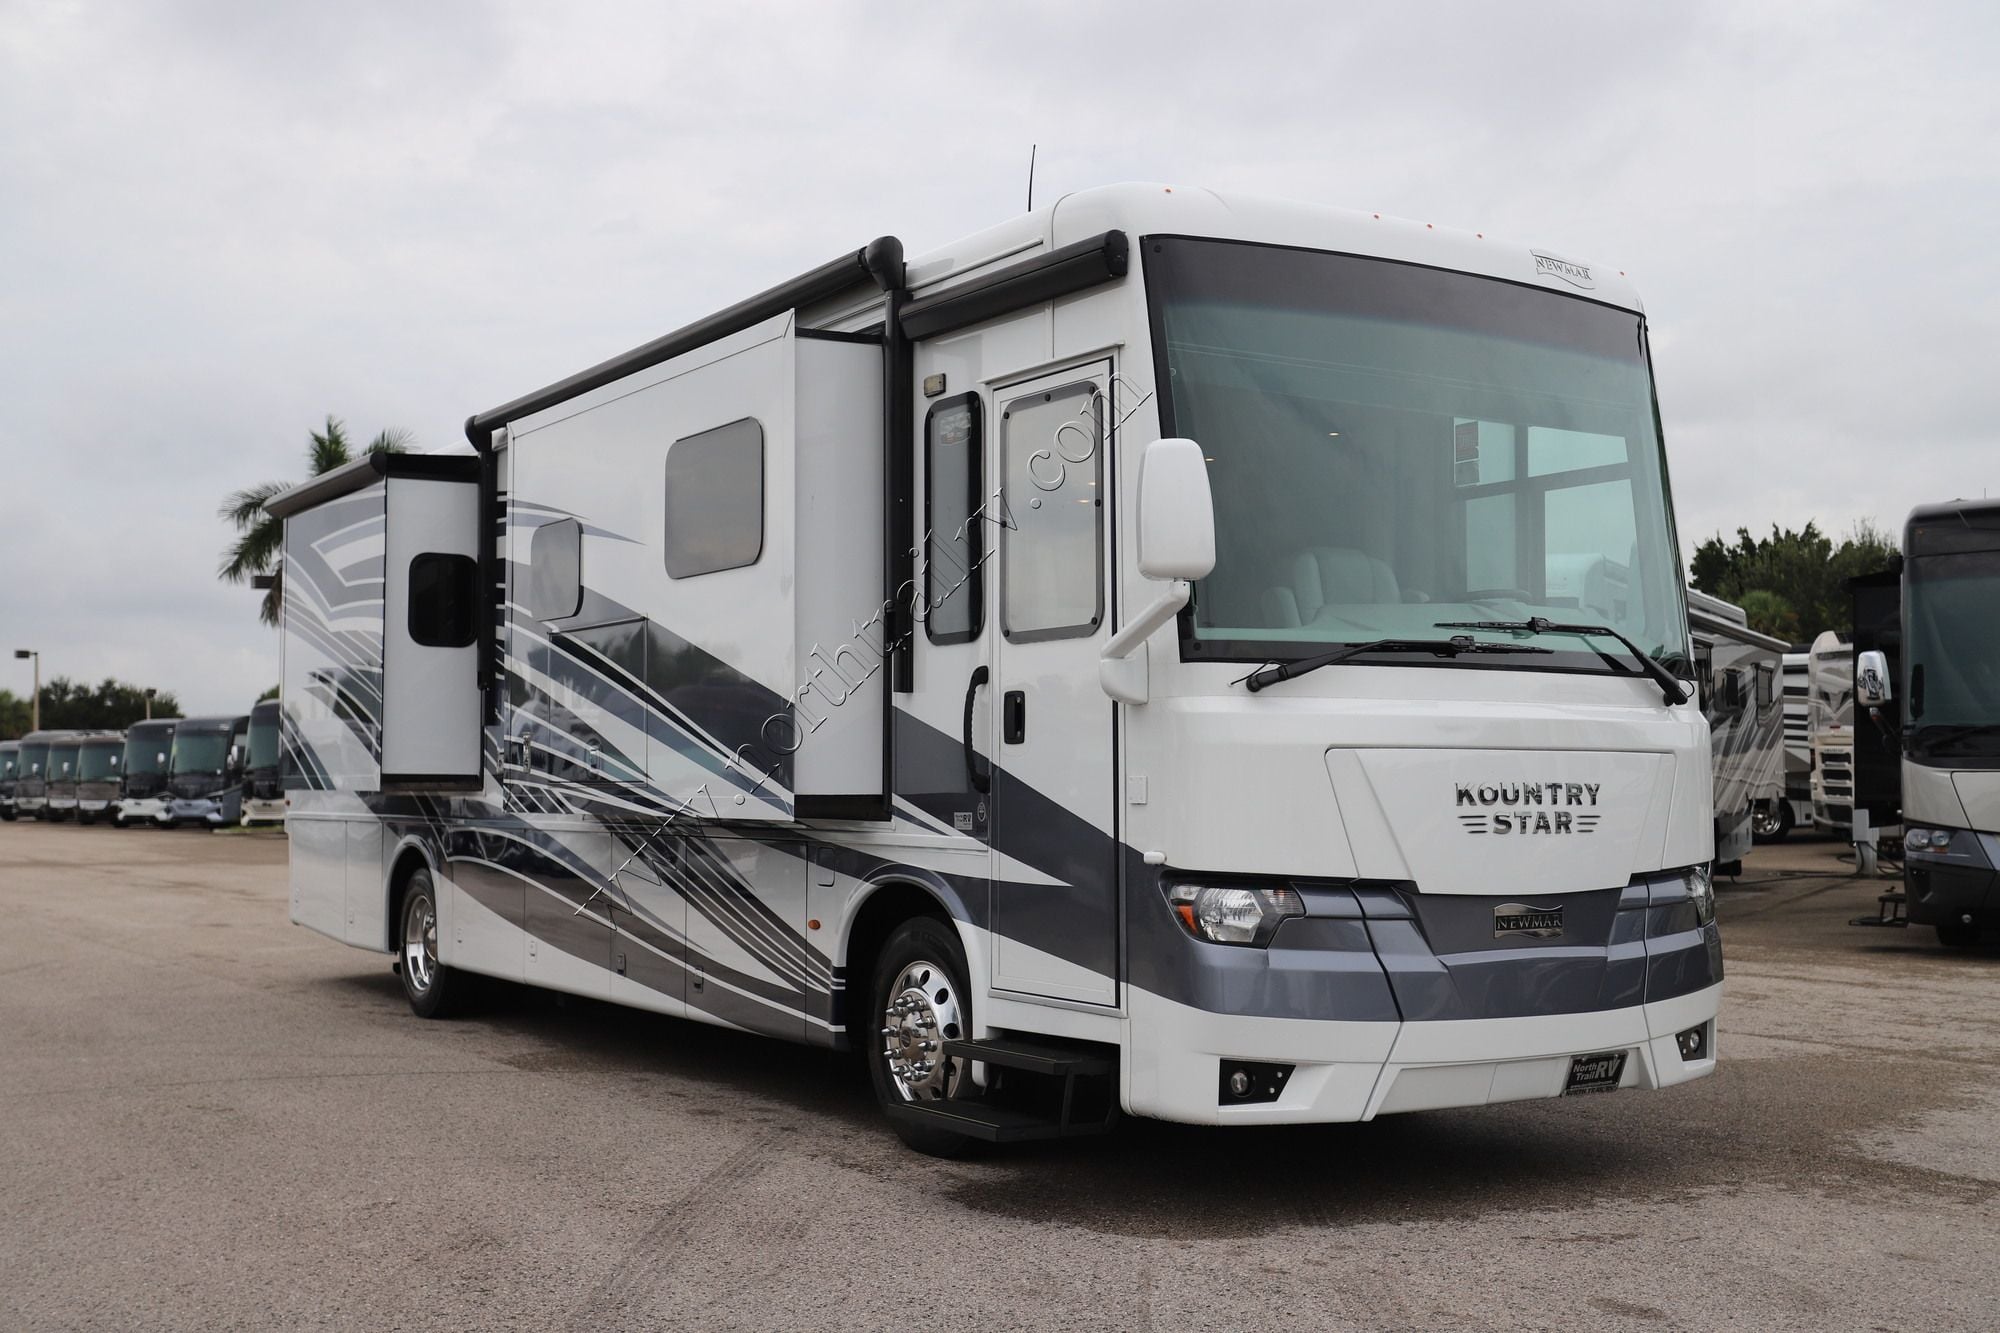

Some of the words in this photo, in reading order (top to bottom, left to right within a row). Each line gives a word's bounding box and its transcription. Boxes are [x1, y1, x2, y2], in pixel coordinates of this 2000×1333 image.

[1535, 256, 1592, 281] NEWMAR
[1455, 782, 1600, 806] KOUNTRY
[1492, 811, 1573, 834] STAR
[1497, 914, 1562, 929] NEWMAR
[1573, 1062, 1598, 1073] North
[1576, 1072, 1596, 1080] Trail
[1595, 1059, 1620, 1078] RV
